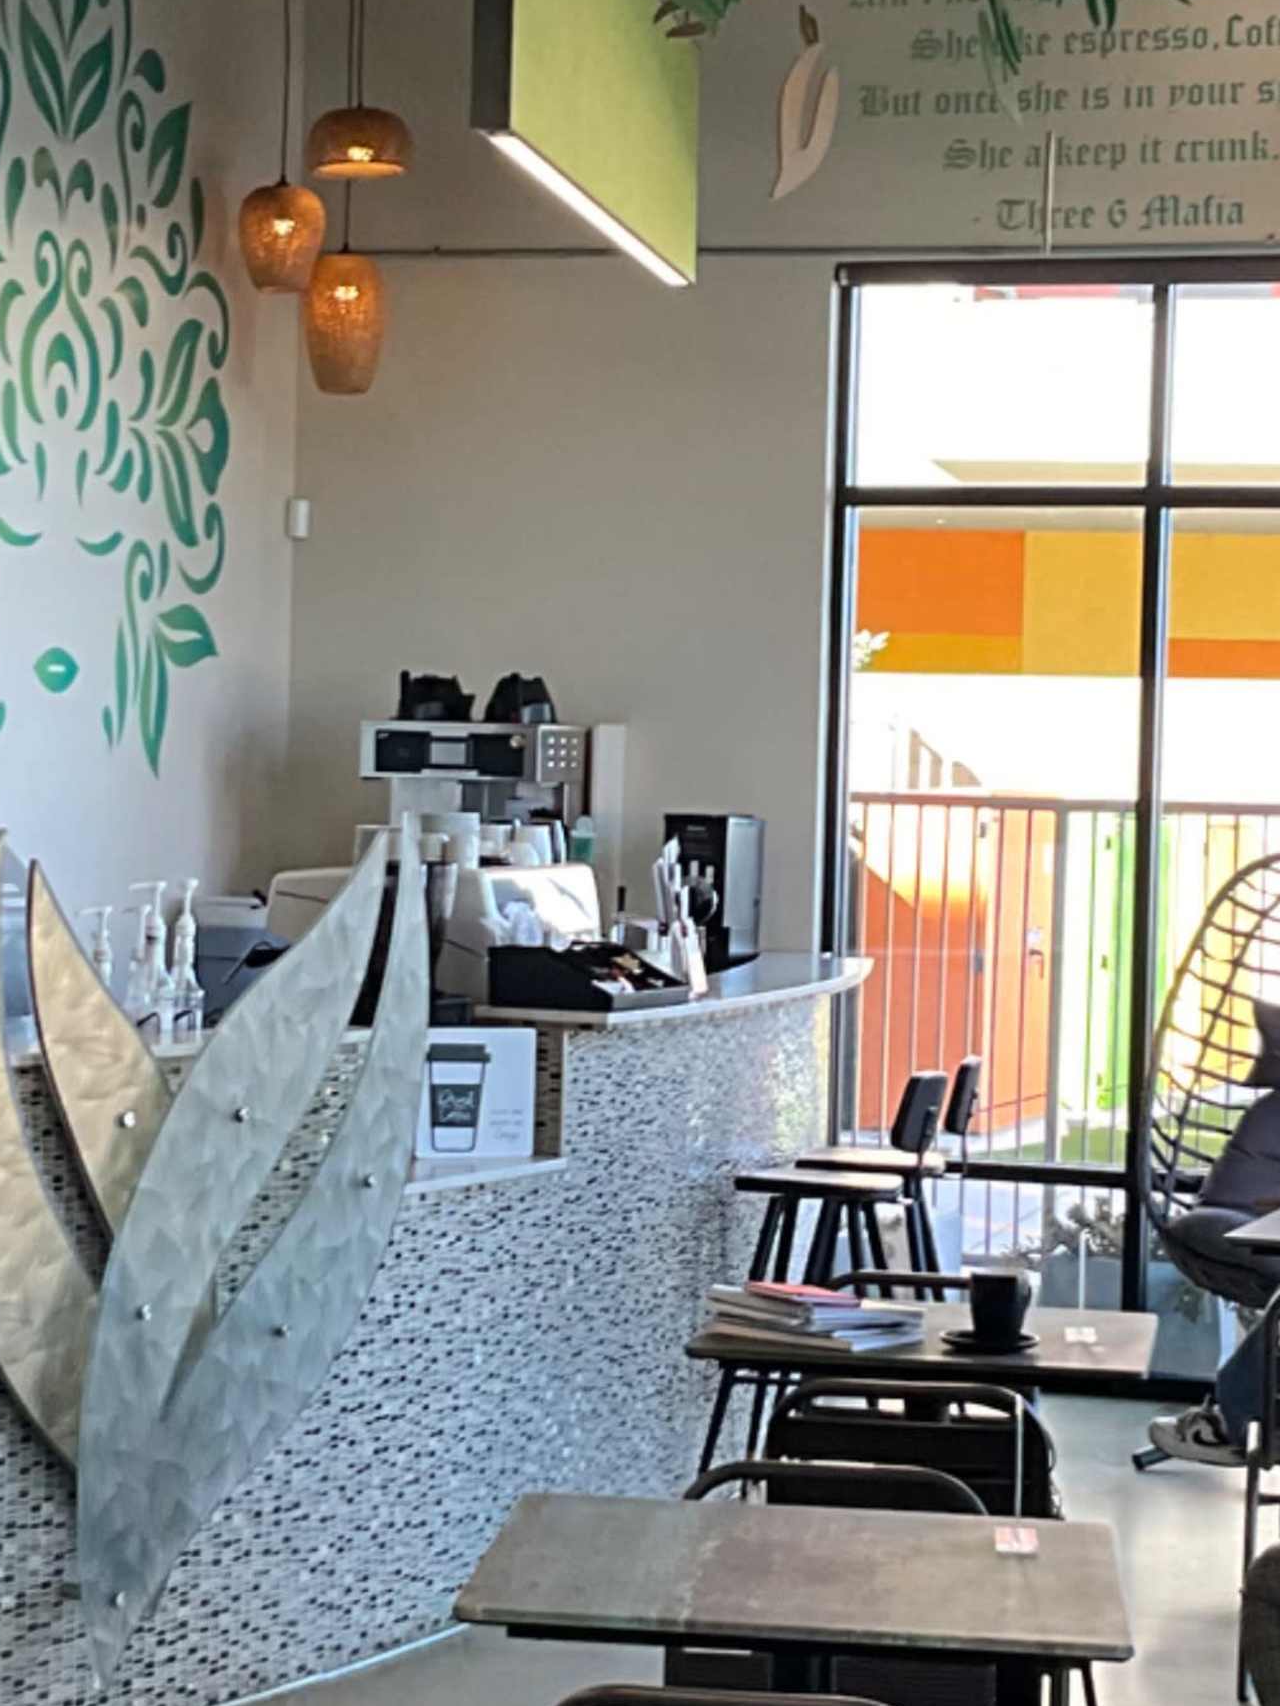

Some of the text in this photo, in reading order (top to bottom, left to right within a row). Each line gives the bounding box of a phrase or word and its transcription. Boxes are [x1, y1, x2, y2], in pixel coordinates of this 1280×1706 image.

[910, 29, 977, 63] She
[859, 84, 922, 117] But
[1018, 81, 1069, 116] she
[1081, 84, 1111, 112] is
[1123, 83, 1155, 110] in
[1168, 80, 1245, 111] your
[942, 137, 1014, 171] She
[1140, 136, 1162, 165] it
[1174, 129, 1280, 164] crunk.
[997, 197, 1096, 235] Three
[1106, 197, 1128, 230] 6
[1138, 194, 1245, 231] Mafia
